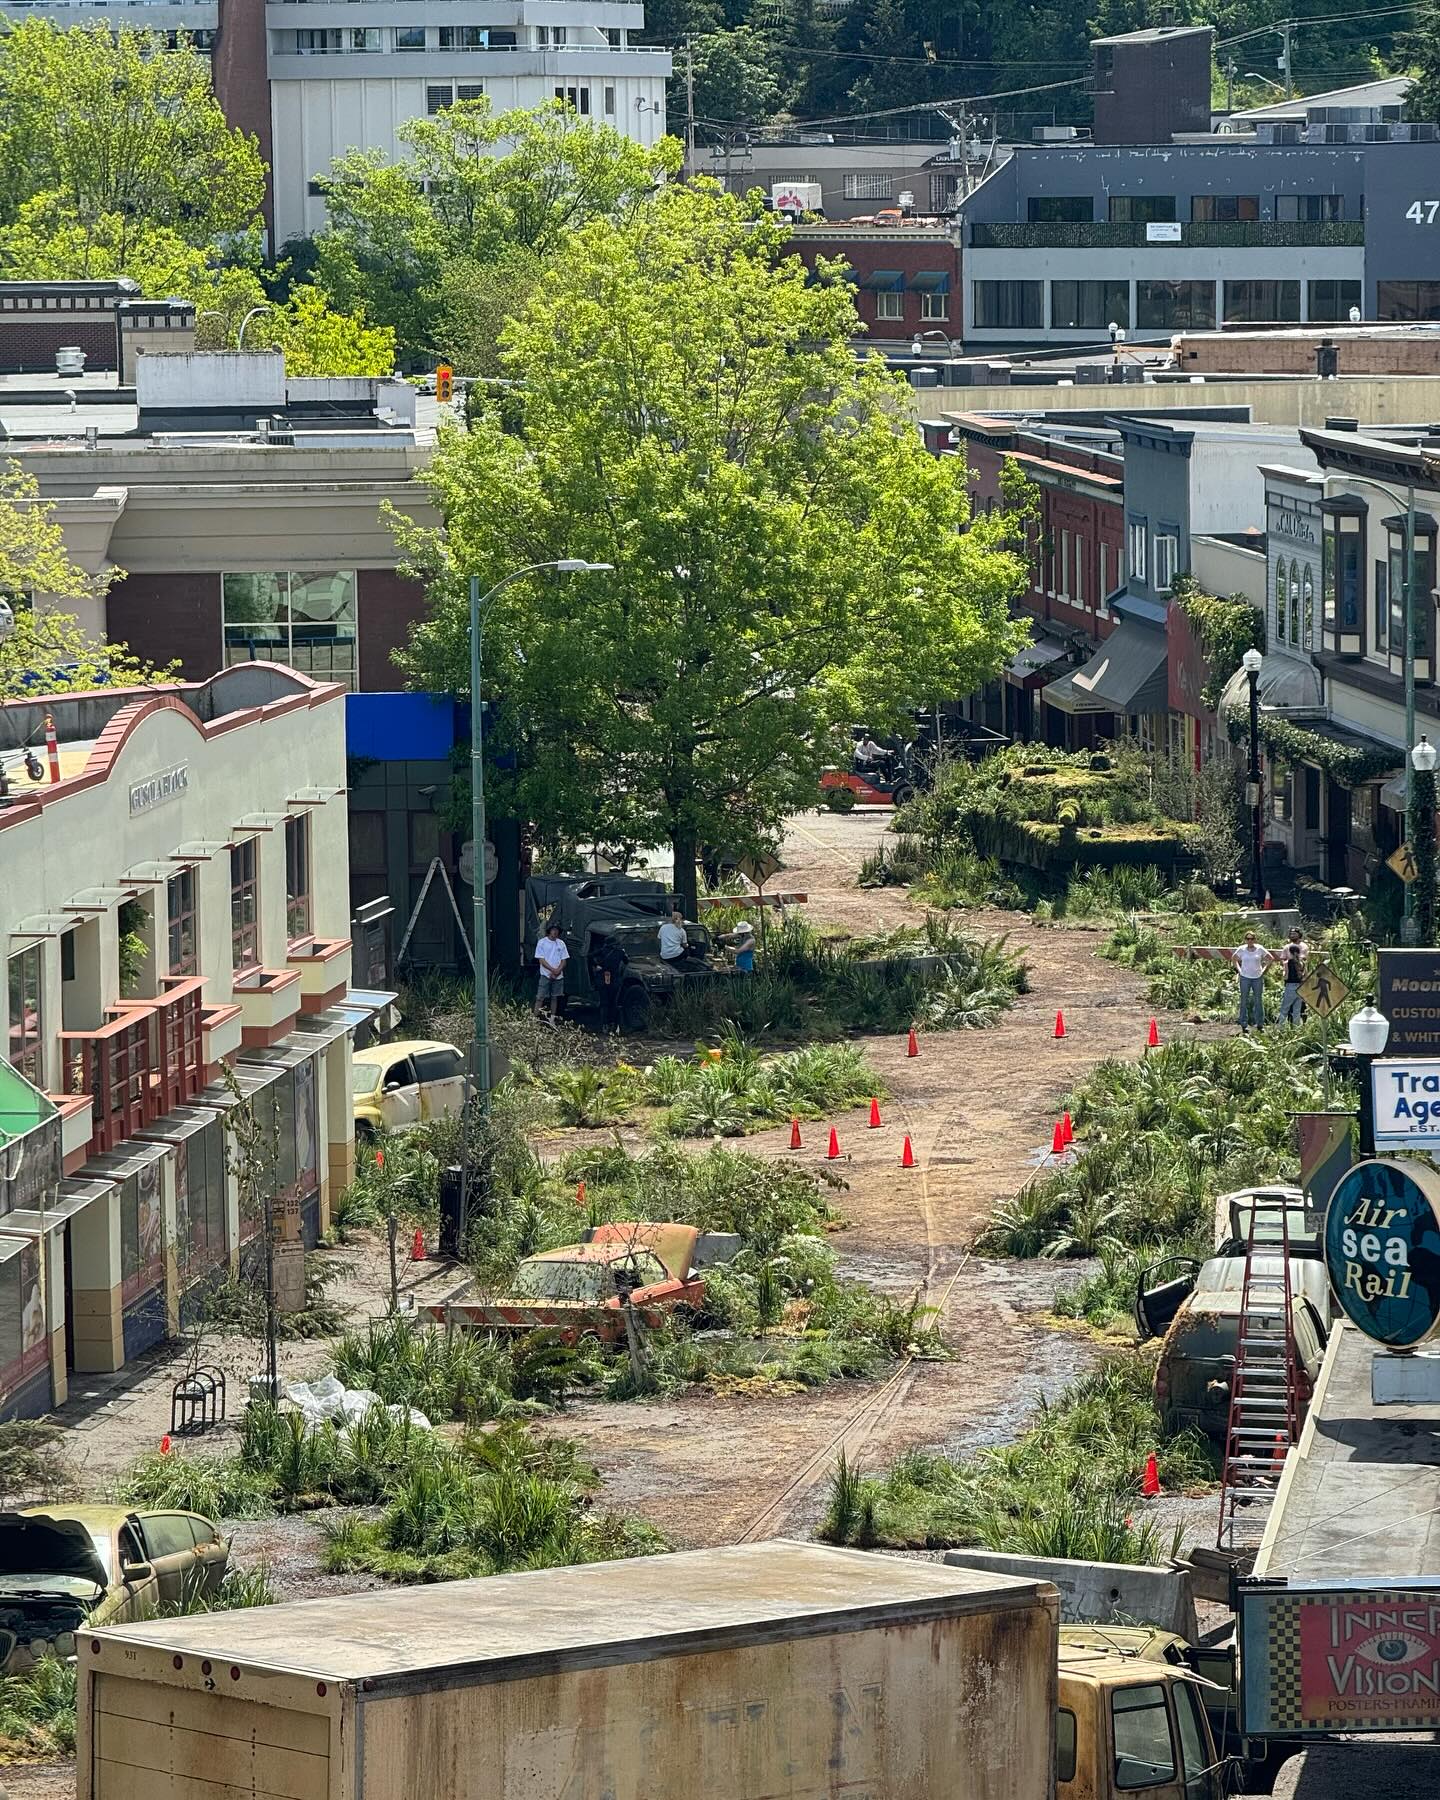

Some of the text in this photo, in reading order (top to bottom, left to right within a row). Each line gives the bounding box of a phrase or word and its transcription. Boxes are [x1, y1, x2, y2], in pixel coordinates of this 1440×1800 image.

[1405, 201, 1440, 225] 47
[1391, 1007, 1440, 1018] CUSTO
[1391, 1032, 1440, 1042] & WHIT
[1391, 1072, 1440, 1093] Tra
[1394, 1097, 1440, 1125] Age
[1409, 1124, 1440, 1133] EST.
[1343, 1197, 1408, 1229] Air
[1342, 1228, 1410, 1267] sea
[1344, 1260, 1413, 1302] Rail
[1327, 1655, 1440, 1697] VISION
